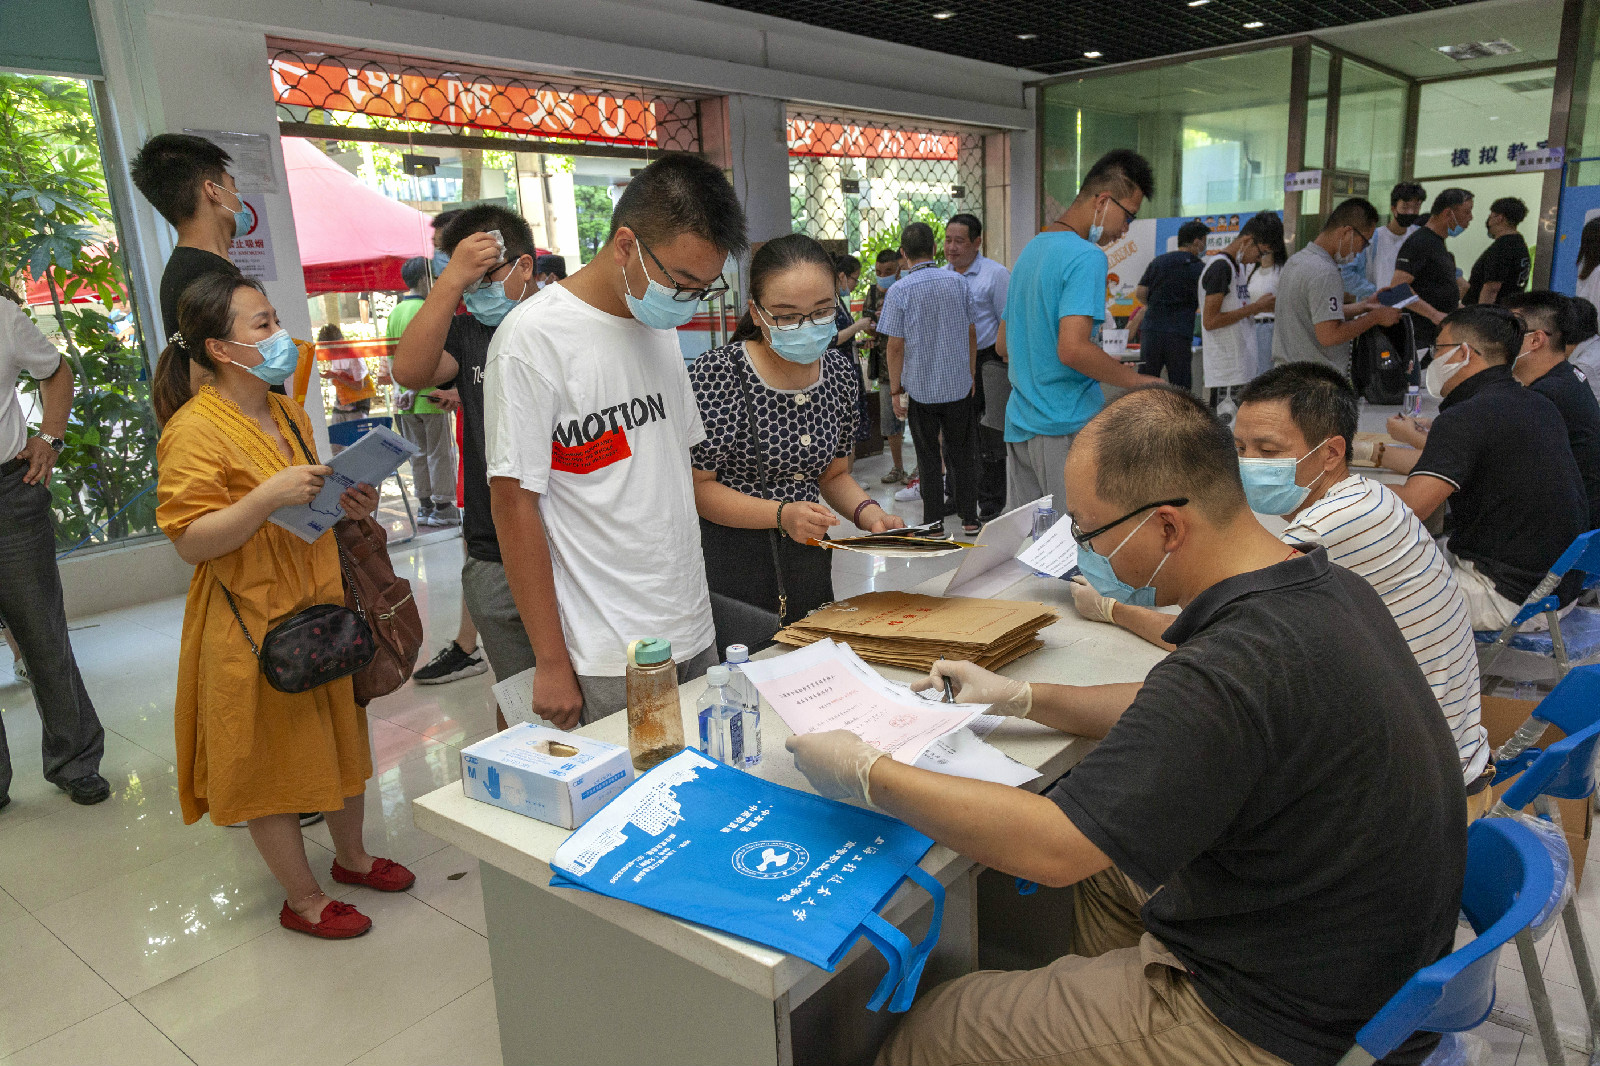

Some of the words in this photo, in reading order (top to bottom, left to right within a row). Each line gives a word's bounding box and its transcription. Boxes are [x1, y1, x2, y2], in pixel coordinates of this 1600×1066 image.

[1329, 296, 1338, 312] 3
[552, 393, 667, 447] MOTION
[467, 765, 477, 780] M
